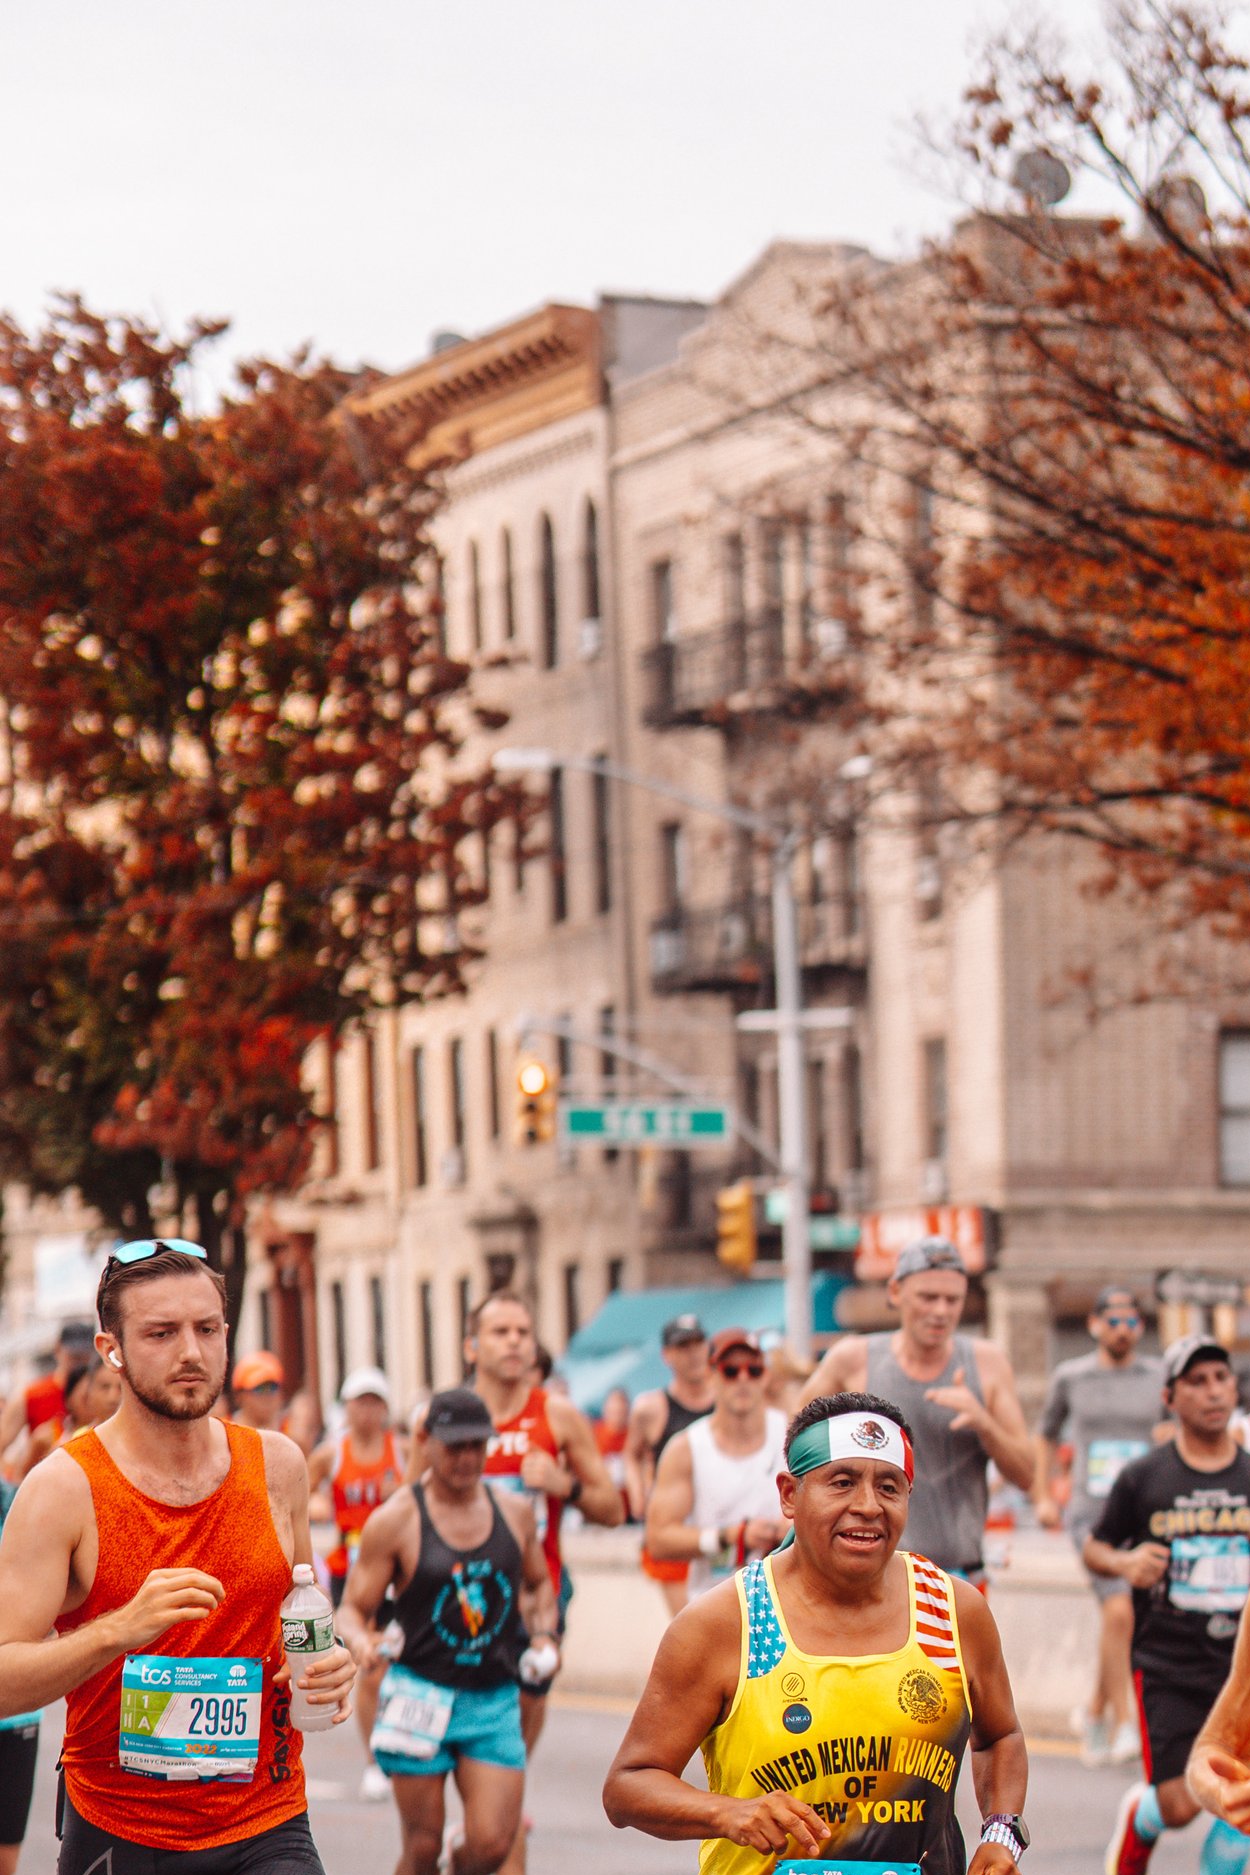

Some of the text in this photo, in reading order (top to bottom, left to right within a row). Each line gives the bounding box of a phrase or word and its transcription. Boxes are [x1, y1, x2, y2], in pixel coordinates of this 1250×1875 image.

[141, 1664, 171, 1685] tcs
[906, 1669, 926, 1678] MEXICAN
[142, 1695, 149, 1709] 1
[138, 1716, 151, 1730] A
[188, 1697, 248, 1736] 2995
[185, 1743, 217, 1754] 2022
[750, 1736, 957, 1795] UNITED MEXICAN RUNNERS
[844, 1776, 877, 1798] OF
[856, 1800, 926, 1824] YORK
